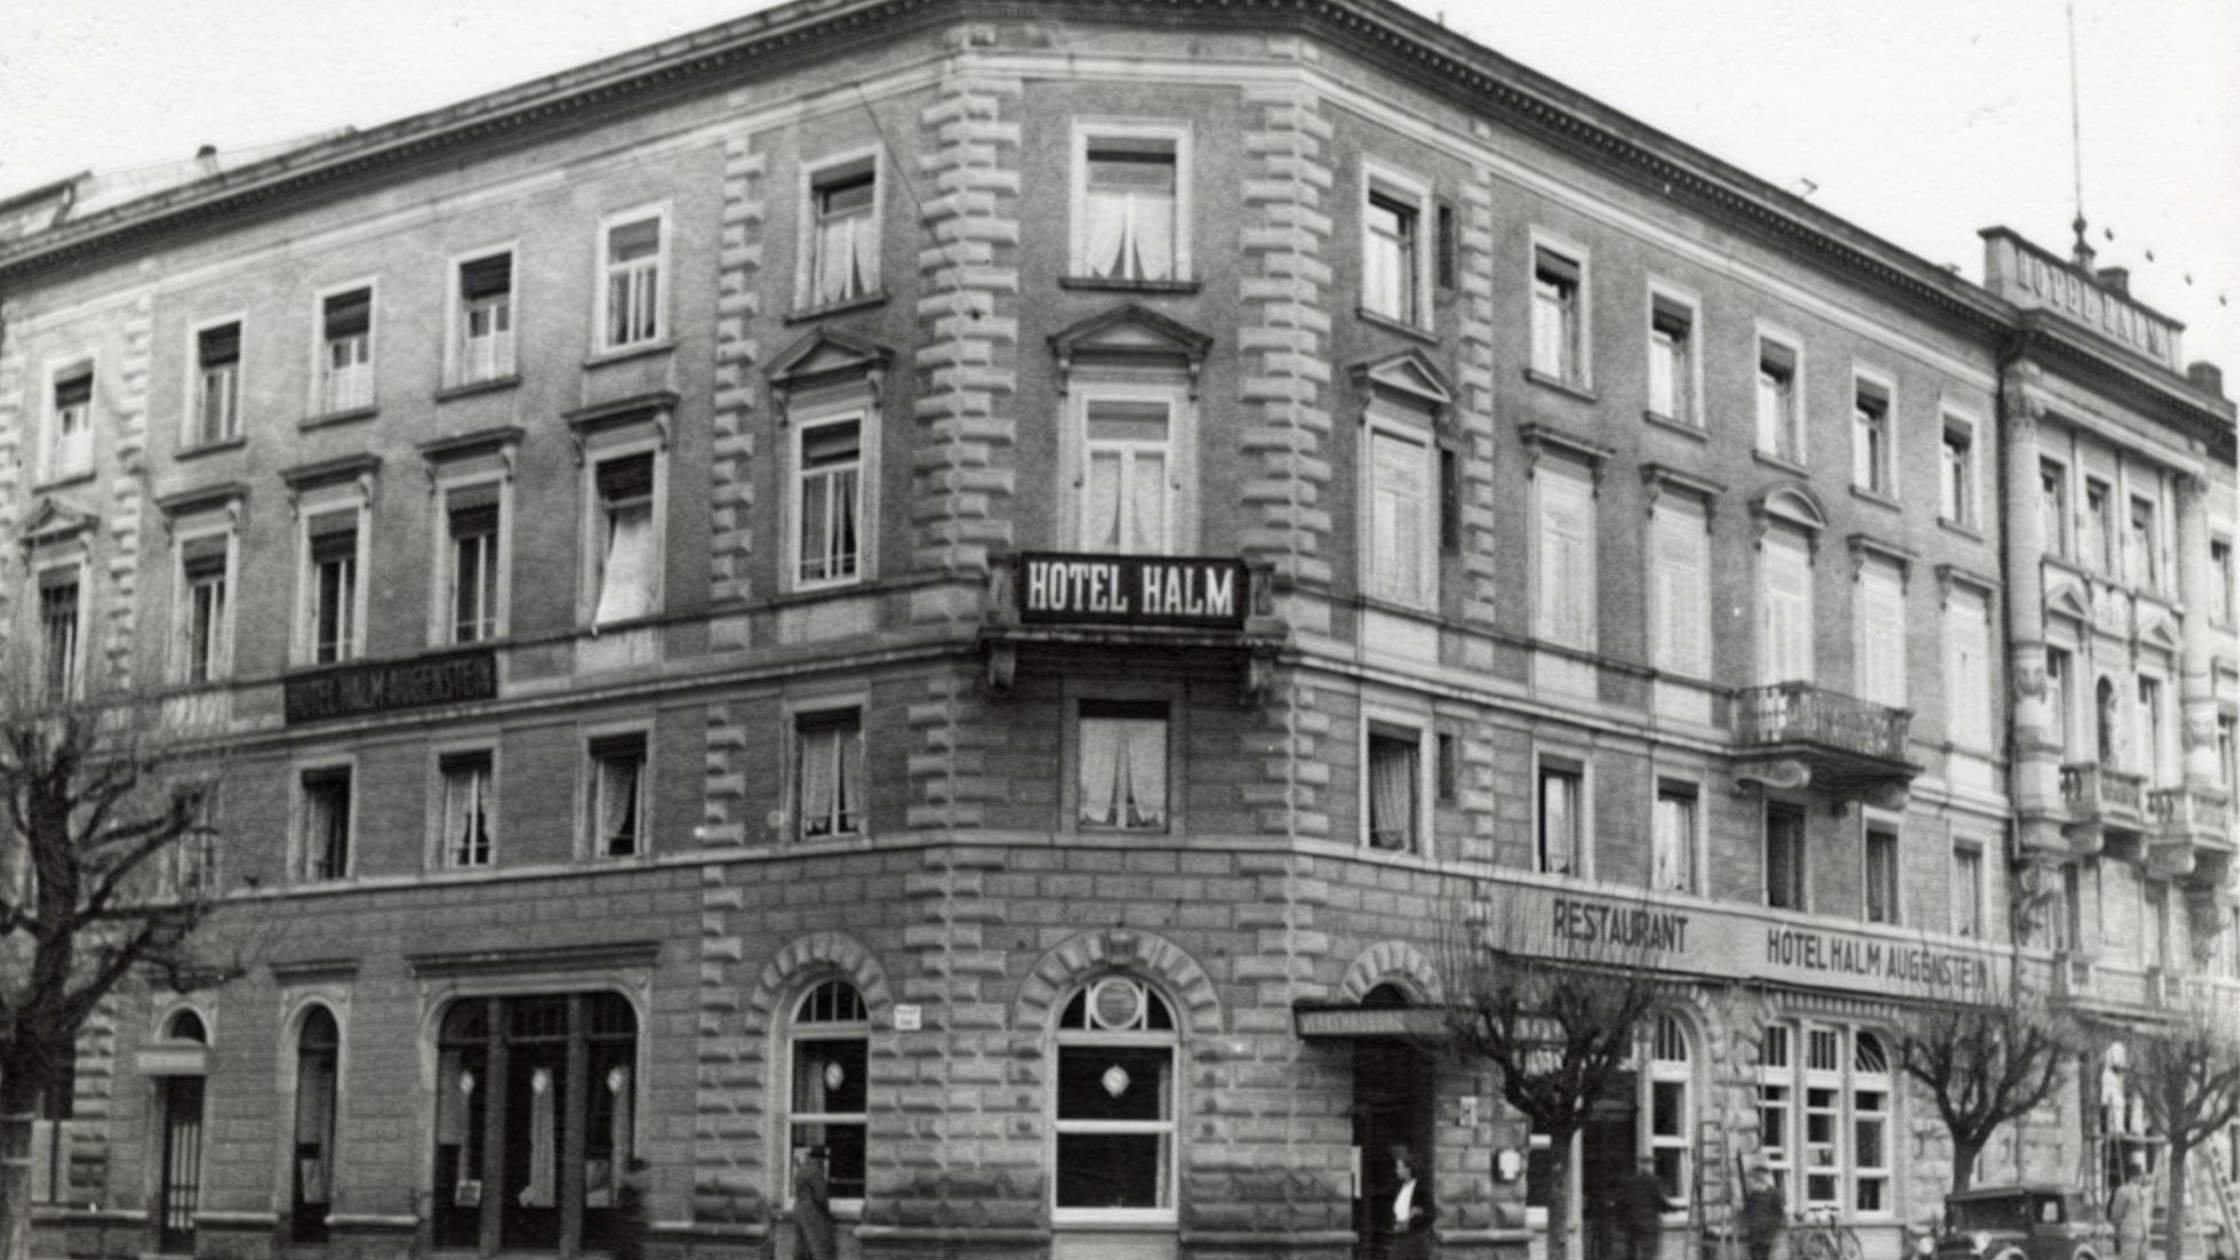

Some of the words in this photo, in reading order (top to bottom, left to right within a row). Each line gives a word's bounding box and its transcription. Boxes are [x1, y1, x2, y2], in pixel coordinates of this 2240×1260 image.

[1028, 561, 1128, 613] HOTEL
[1142, 565, 1234, 616] HALM
[288, 678, 335, 717] HOTEL
[340, 670, 384, 709] HALM
[1553, 898, 1688, 953] RESTAURANT
[1767, 929, 1827, 970] HOTEL
[1831, 938, 1880, 976] HALM
[1887, 945, 1987, 990] AUGENSTEIN
